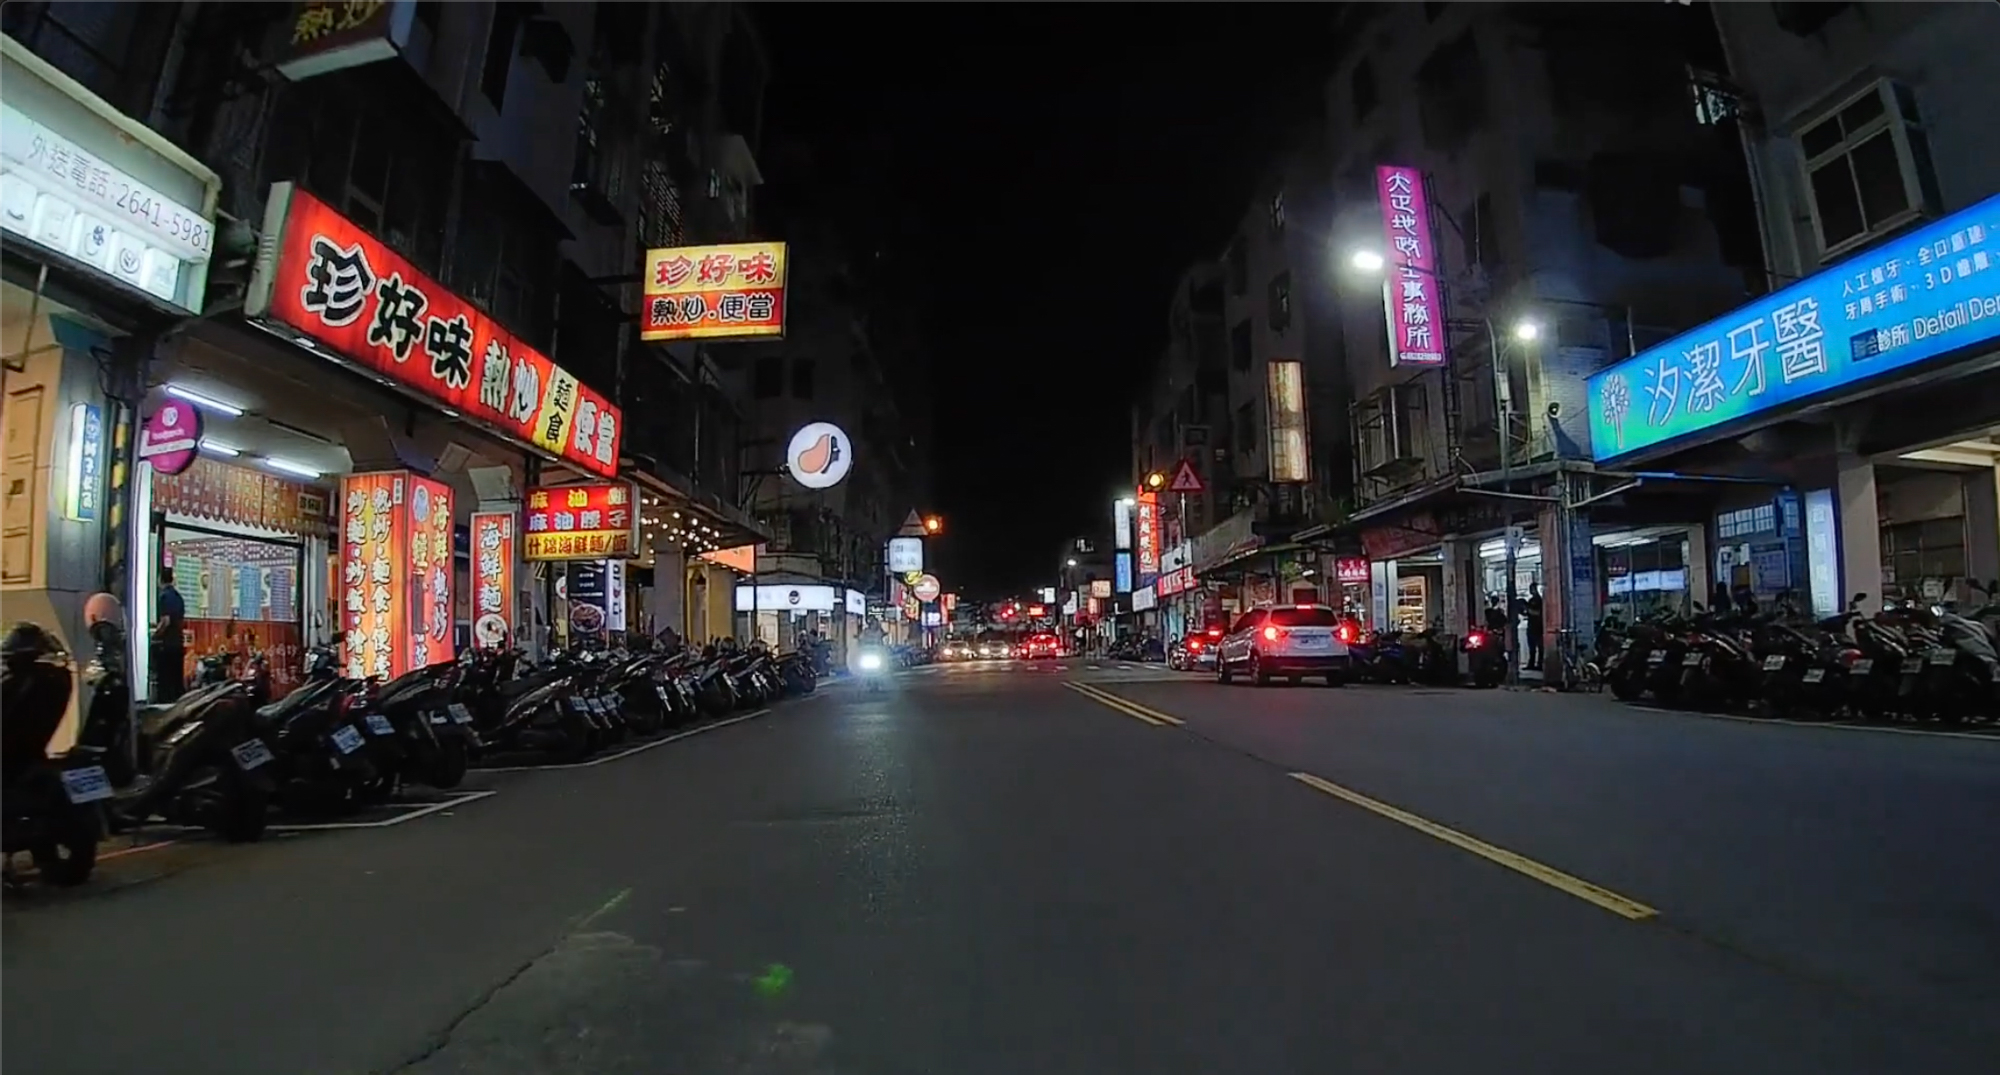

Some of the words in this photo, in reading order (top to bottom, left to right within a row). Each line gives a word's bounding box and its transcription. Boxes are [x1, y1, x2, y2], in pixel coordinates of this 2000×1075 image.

[655, 251, 777, 287] 珍好味
[301, 234, 474, 389] 珍好味
[574, 396, 615, 466] 便當
[1644, 297, 1828, 427] 汐潔牙醫
[1913, 302, 1968, 339] Detail
[480, 521, 503, 613] 海鮮麵
